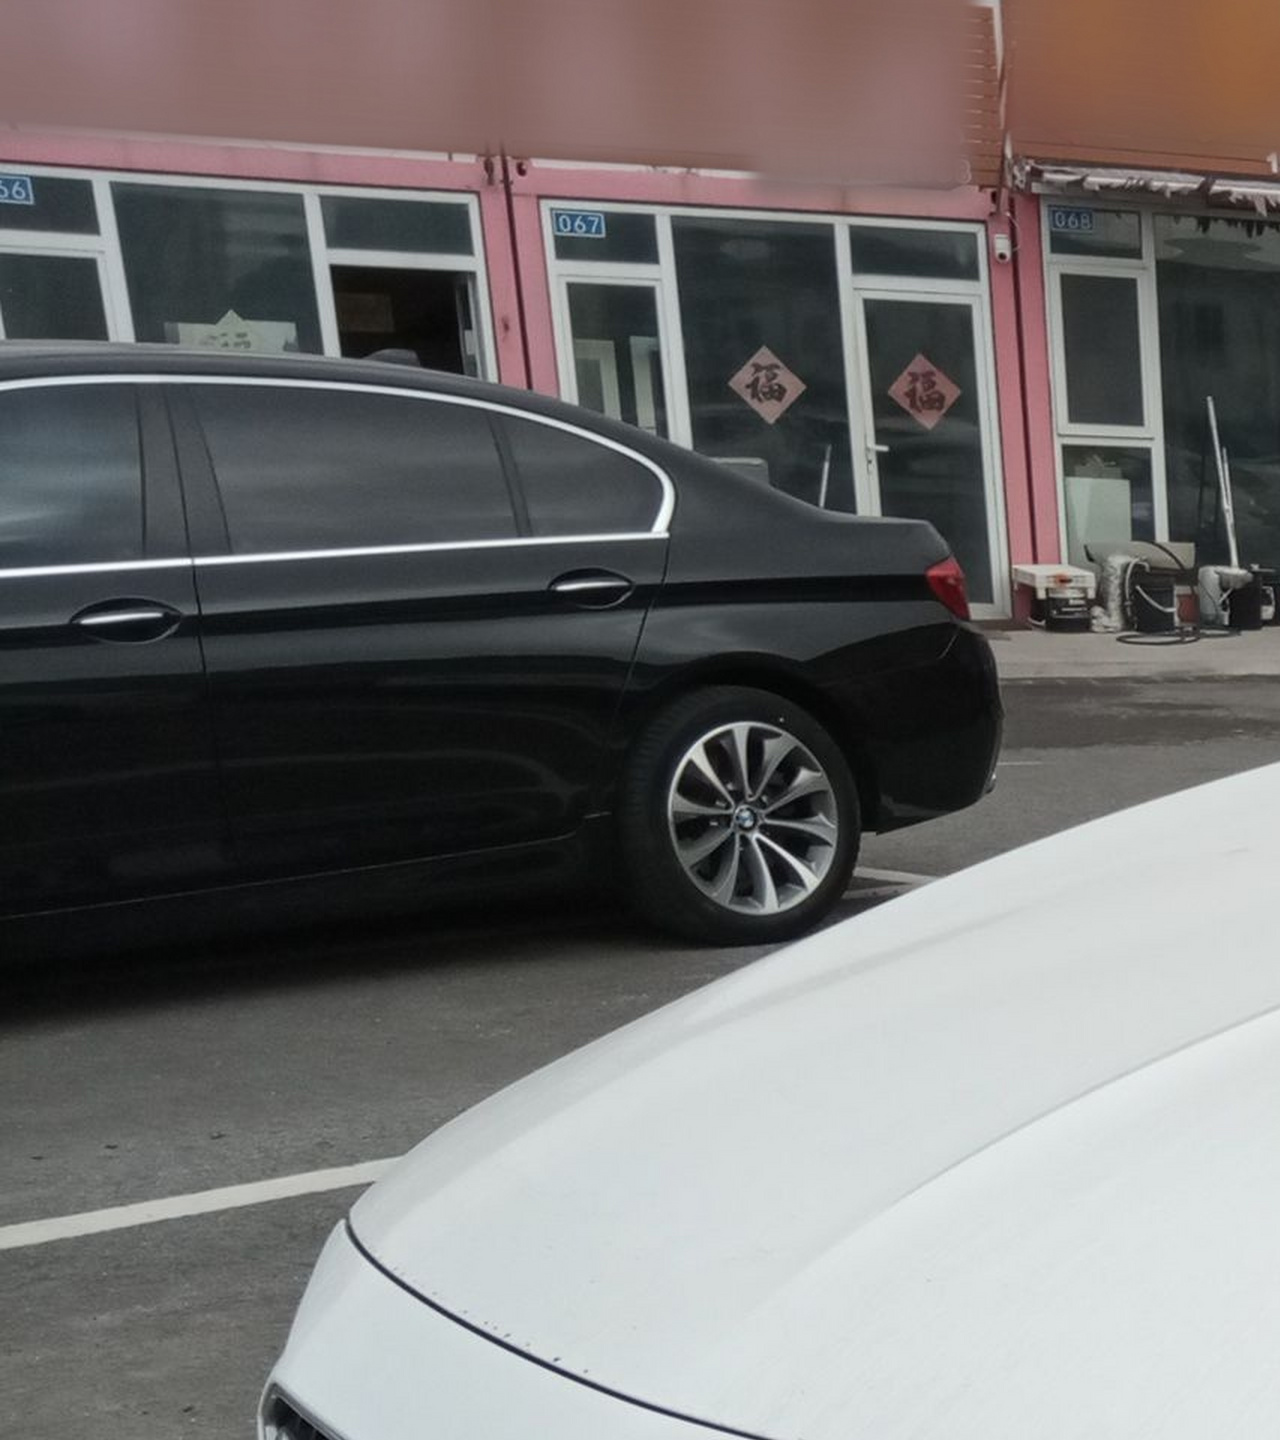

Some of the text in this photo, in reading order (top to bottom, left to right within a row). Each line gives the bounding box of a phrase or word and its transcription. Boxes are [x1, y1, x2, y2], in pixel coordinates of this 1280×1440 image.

[558, 214, 599, 233] 067
[1054, 211, 1091, 230] 068
[745, 362, 788, 403] 福
[904, 370, 947, 413] 福
